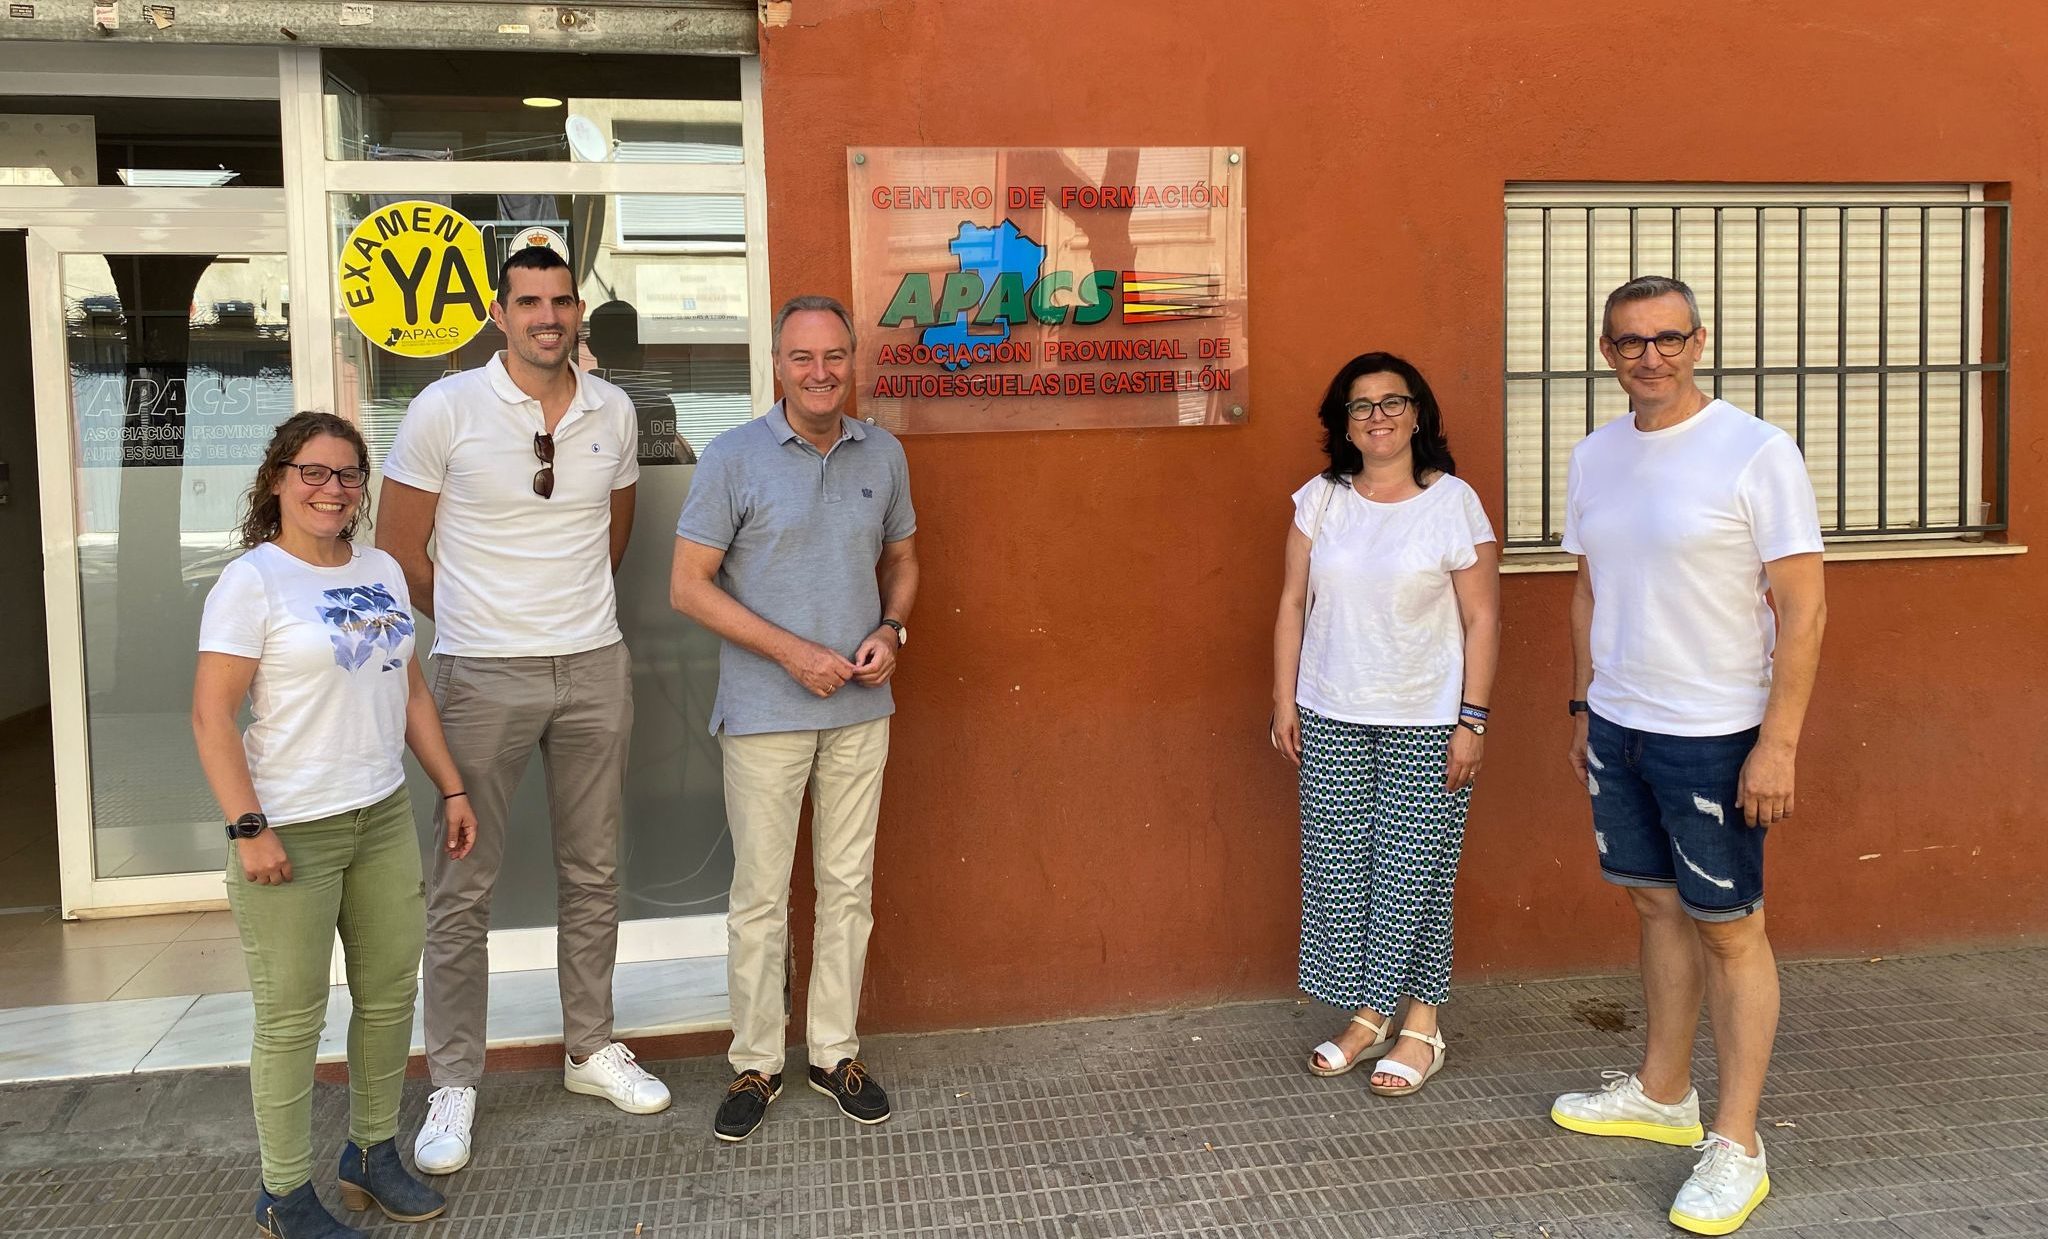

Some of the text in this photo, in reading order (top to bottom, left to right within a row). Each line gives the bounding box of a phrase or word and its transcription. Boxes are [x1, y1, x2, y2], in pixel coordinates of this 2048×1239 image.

[872, 180, 1229, 210] CENTRO DE FORMACIÓN
[343, 207, 463, 308] EXAMEN
[877, 269, 1118, 328] APACS
[402, 327, 459, 340] APACS
[877, 336, 1231, 366] ASOCIACIÓN PROVINCIAL DE
[873, 365, 1231, 398] AUTOESCUELAS DE CASTELLÓN
[84, 378, 252, 416] APACS
[83, 423, 277, 442] ASOCIACIÓN PROVINCIA
[651, 420, 676, 437] DE
[83, 444, 201, 462] AUTOESCUELAS
[208, 445, 227, 459] DE
